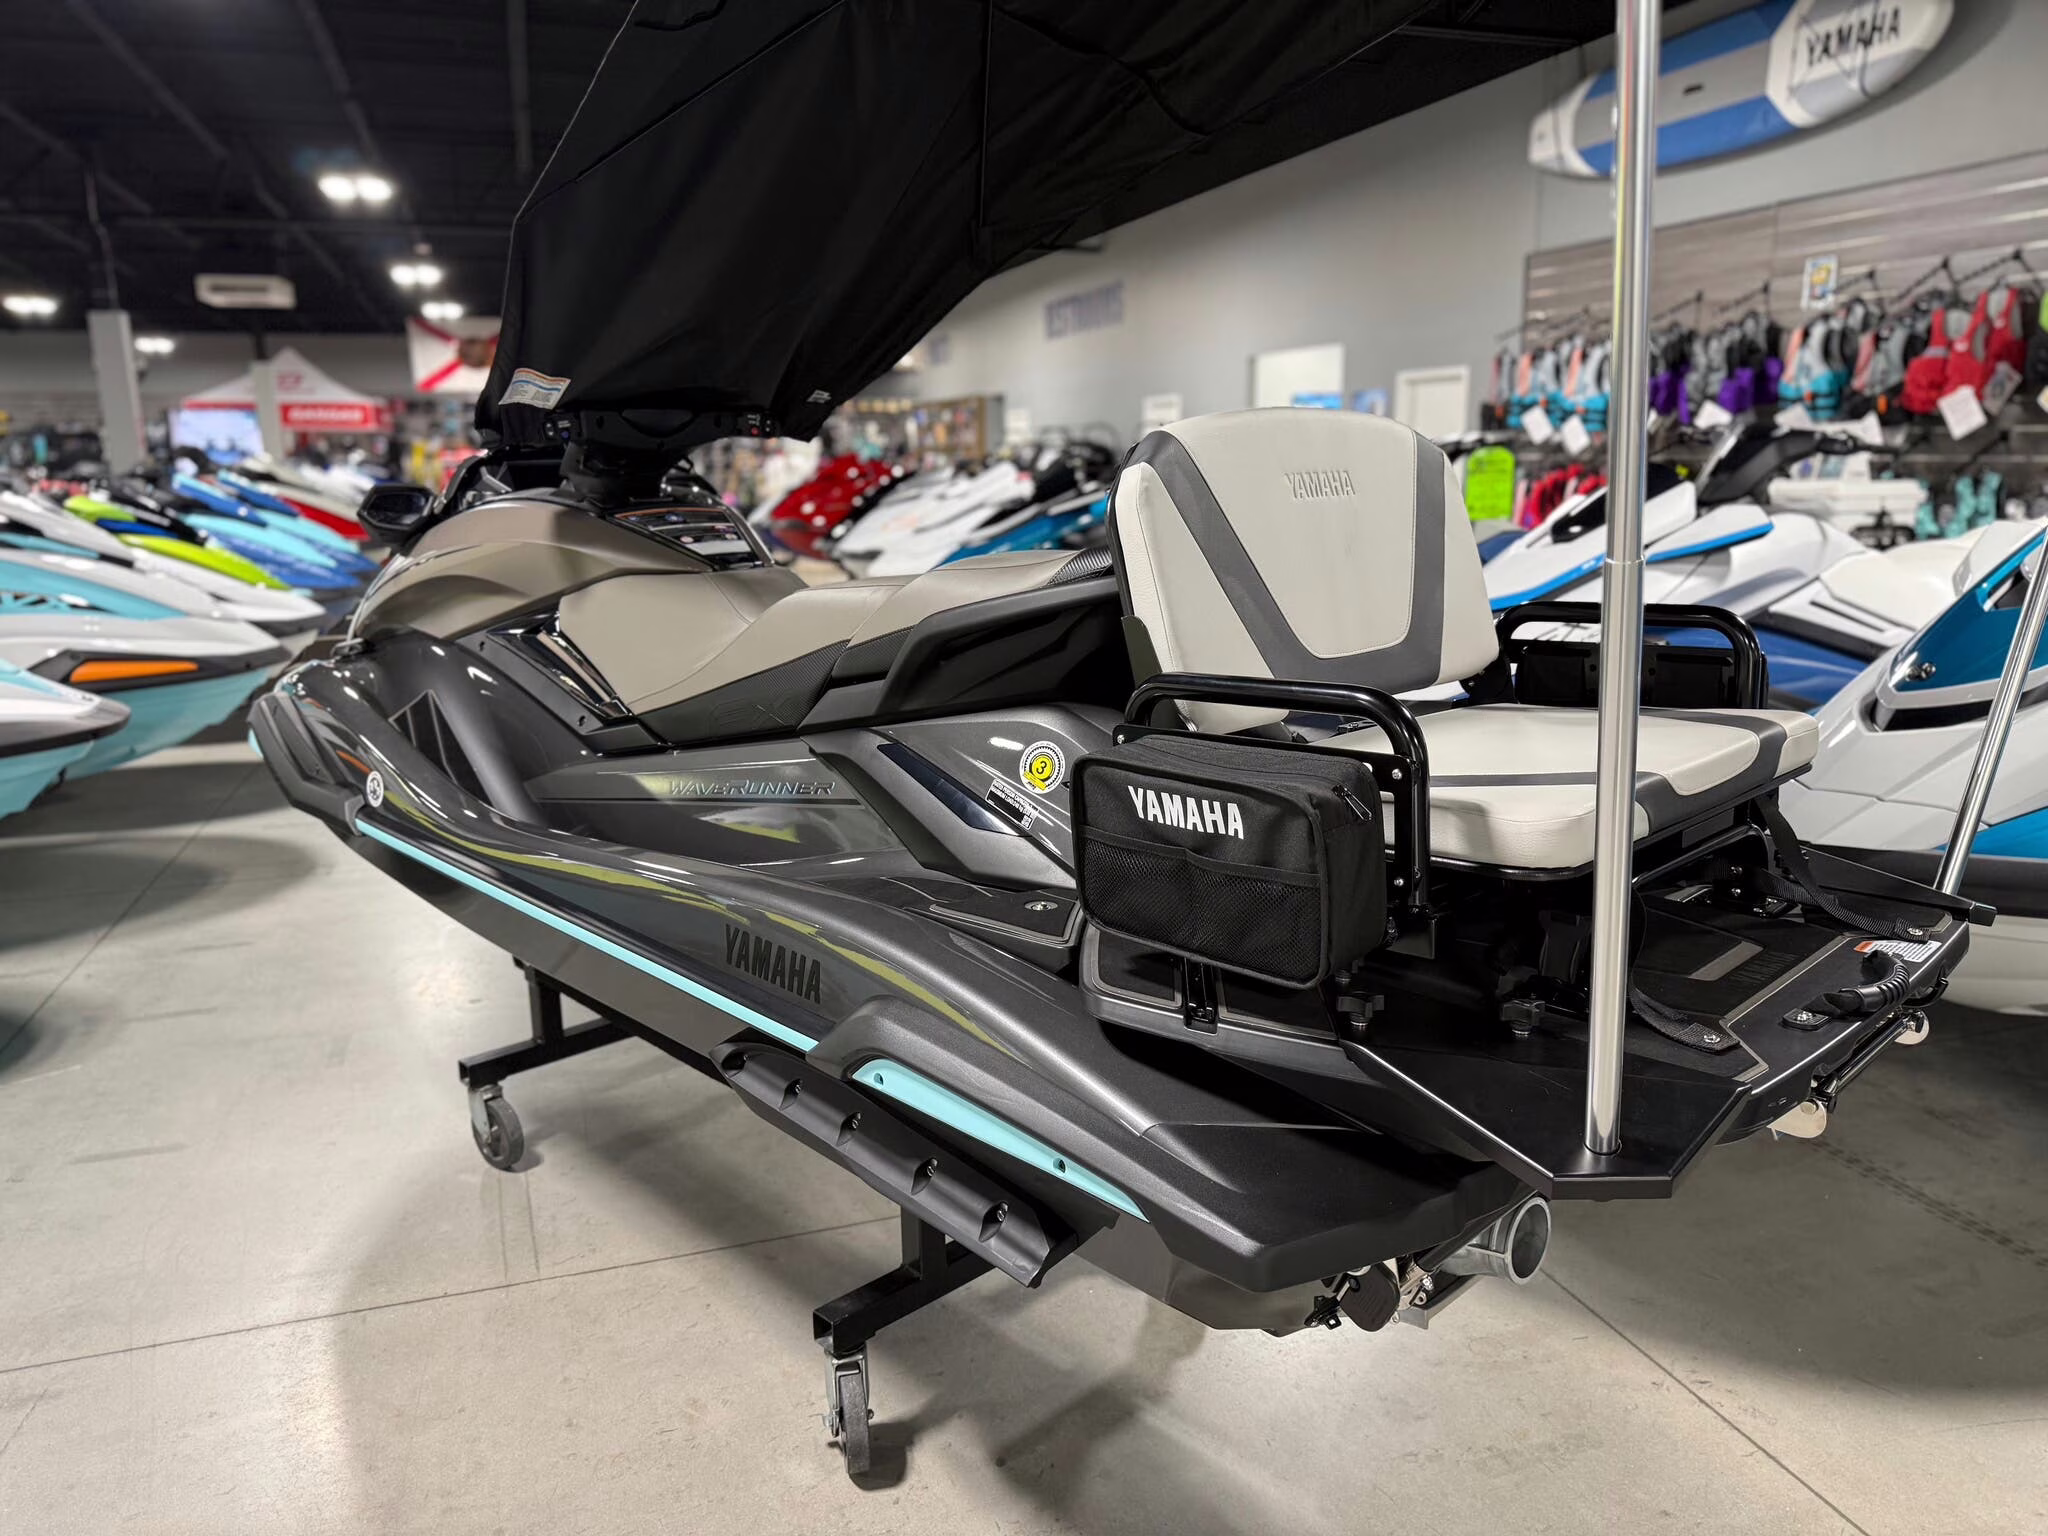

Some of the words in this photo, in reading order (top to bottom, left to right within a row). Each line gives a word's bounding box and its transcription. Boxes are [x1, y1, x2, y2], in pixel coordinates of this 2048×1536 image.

[1806, 6, 1899, 67] YAMAHA
[1284, 470, 1356, 499] YAMAHA
[1036, 760, 1047, 775] 3
[1127, 785, 1244, 840] YAMAHA
[725, 923, 820, 1005] YAMAHA
